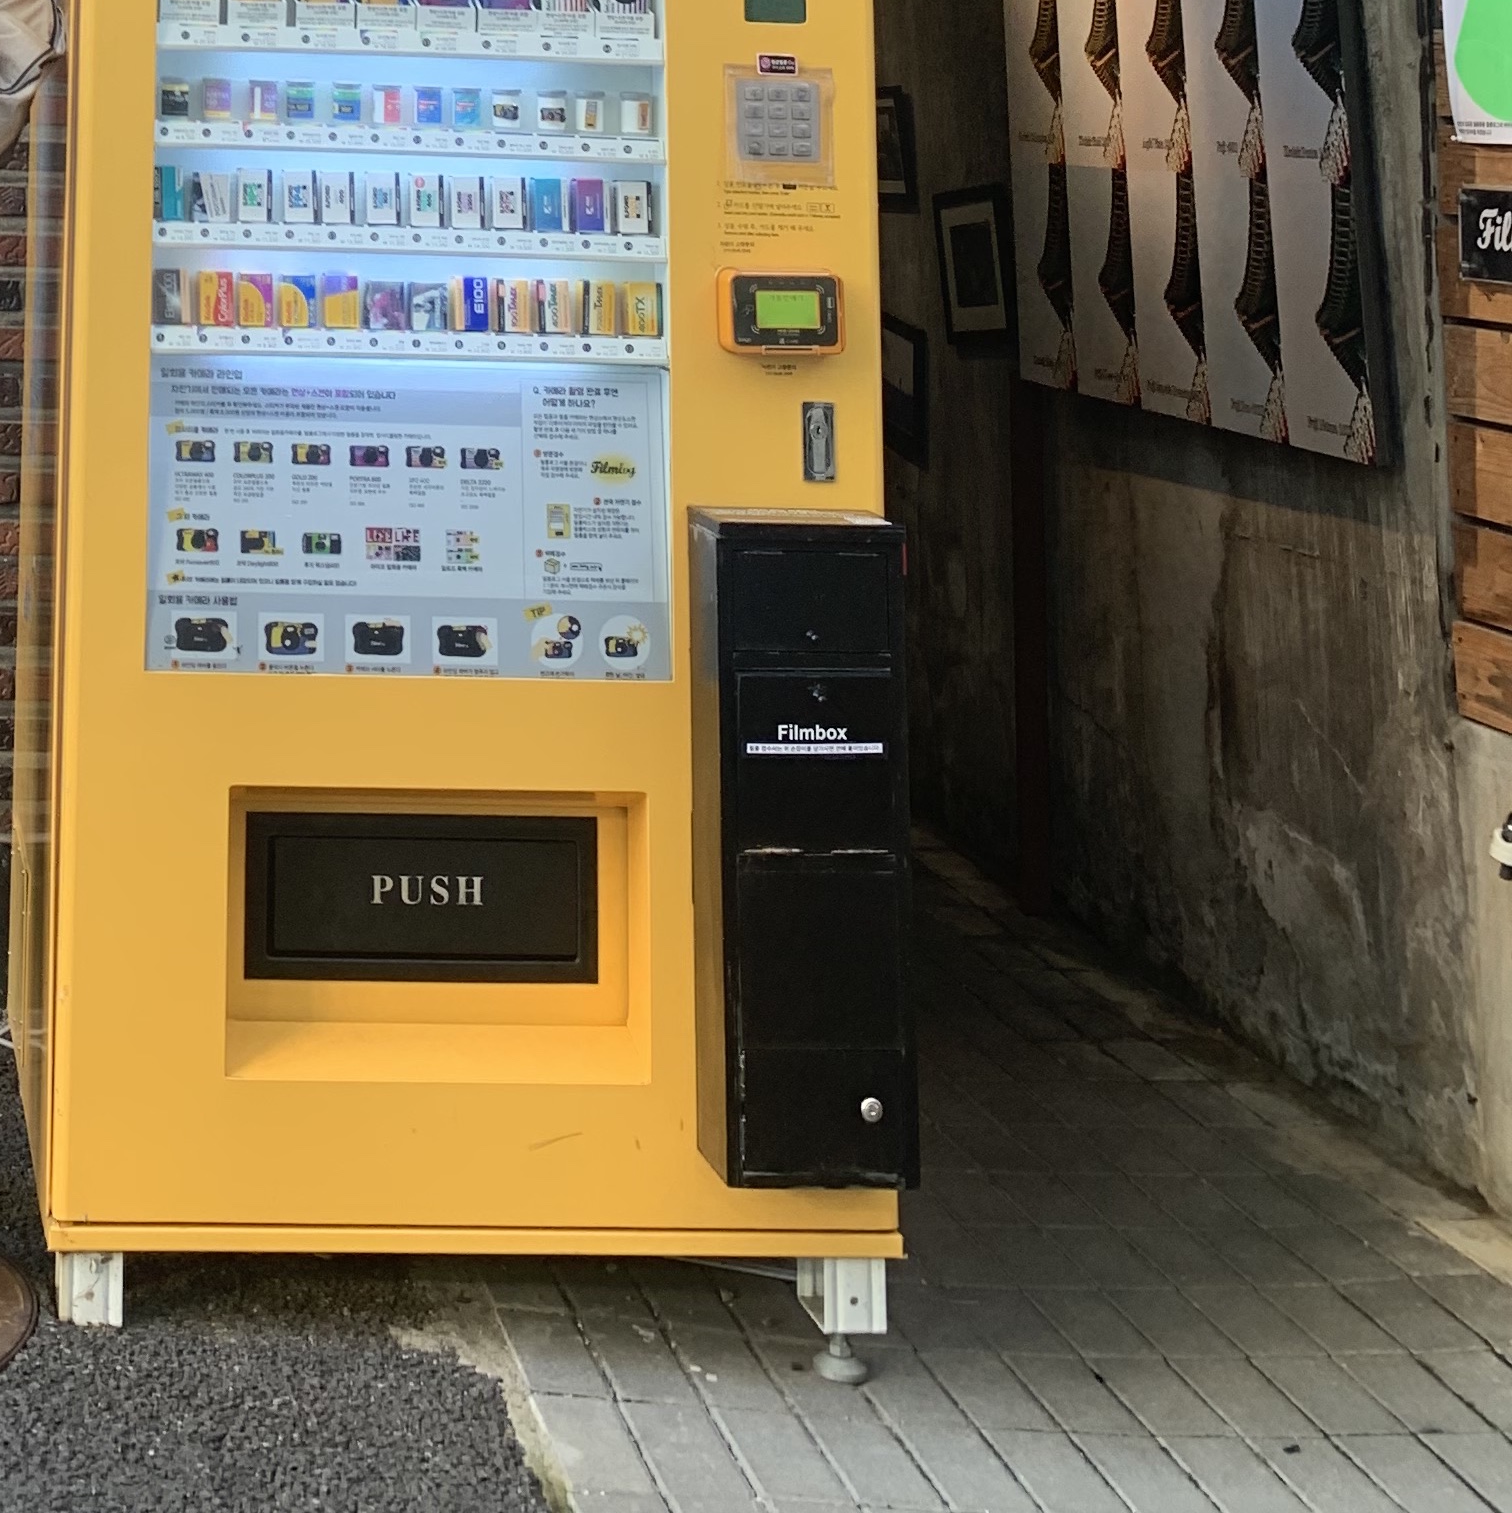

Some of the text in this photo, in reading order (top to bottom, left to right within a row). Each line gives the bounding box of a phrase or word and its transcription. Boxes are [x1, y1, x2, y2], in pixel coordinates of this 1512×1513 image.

[472, 278, 484, 314] E100
[777, 724, 848, 741] Filmbox
[371, 874, 484, 906] PUSH
